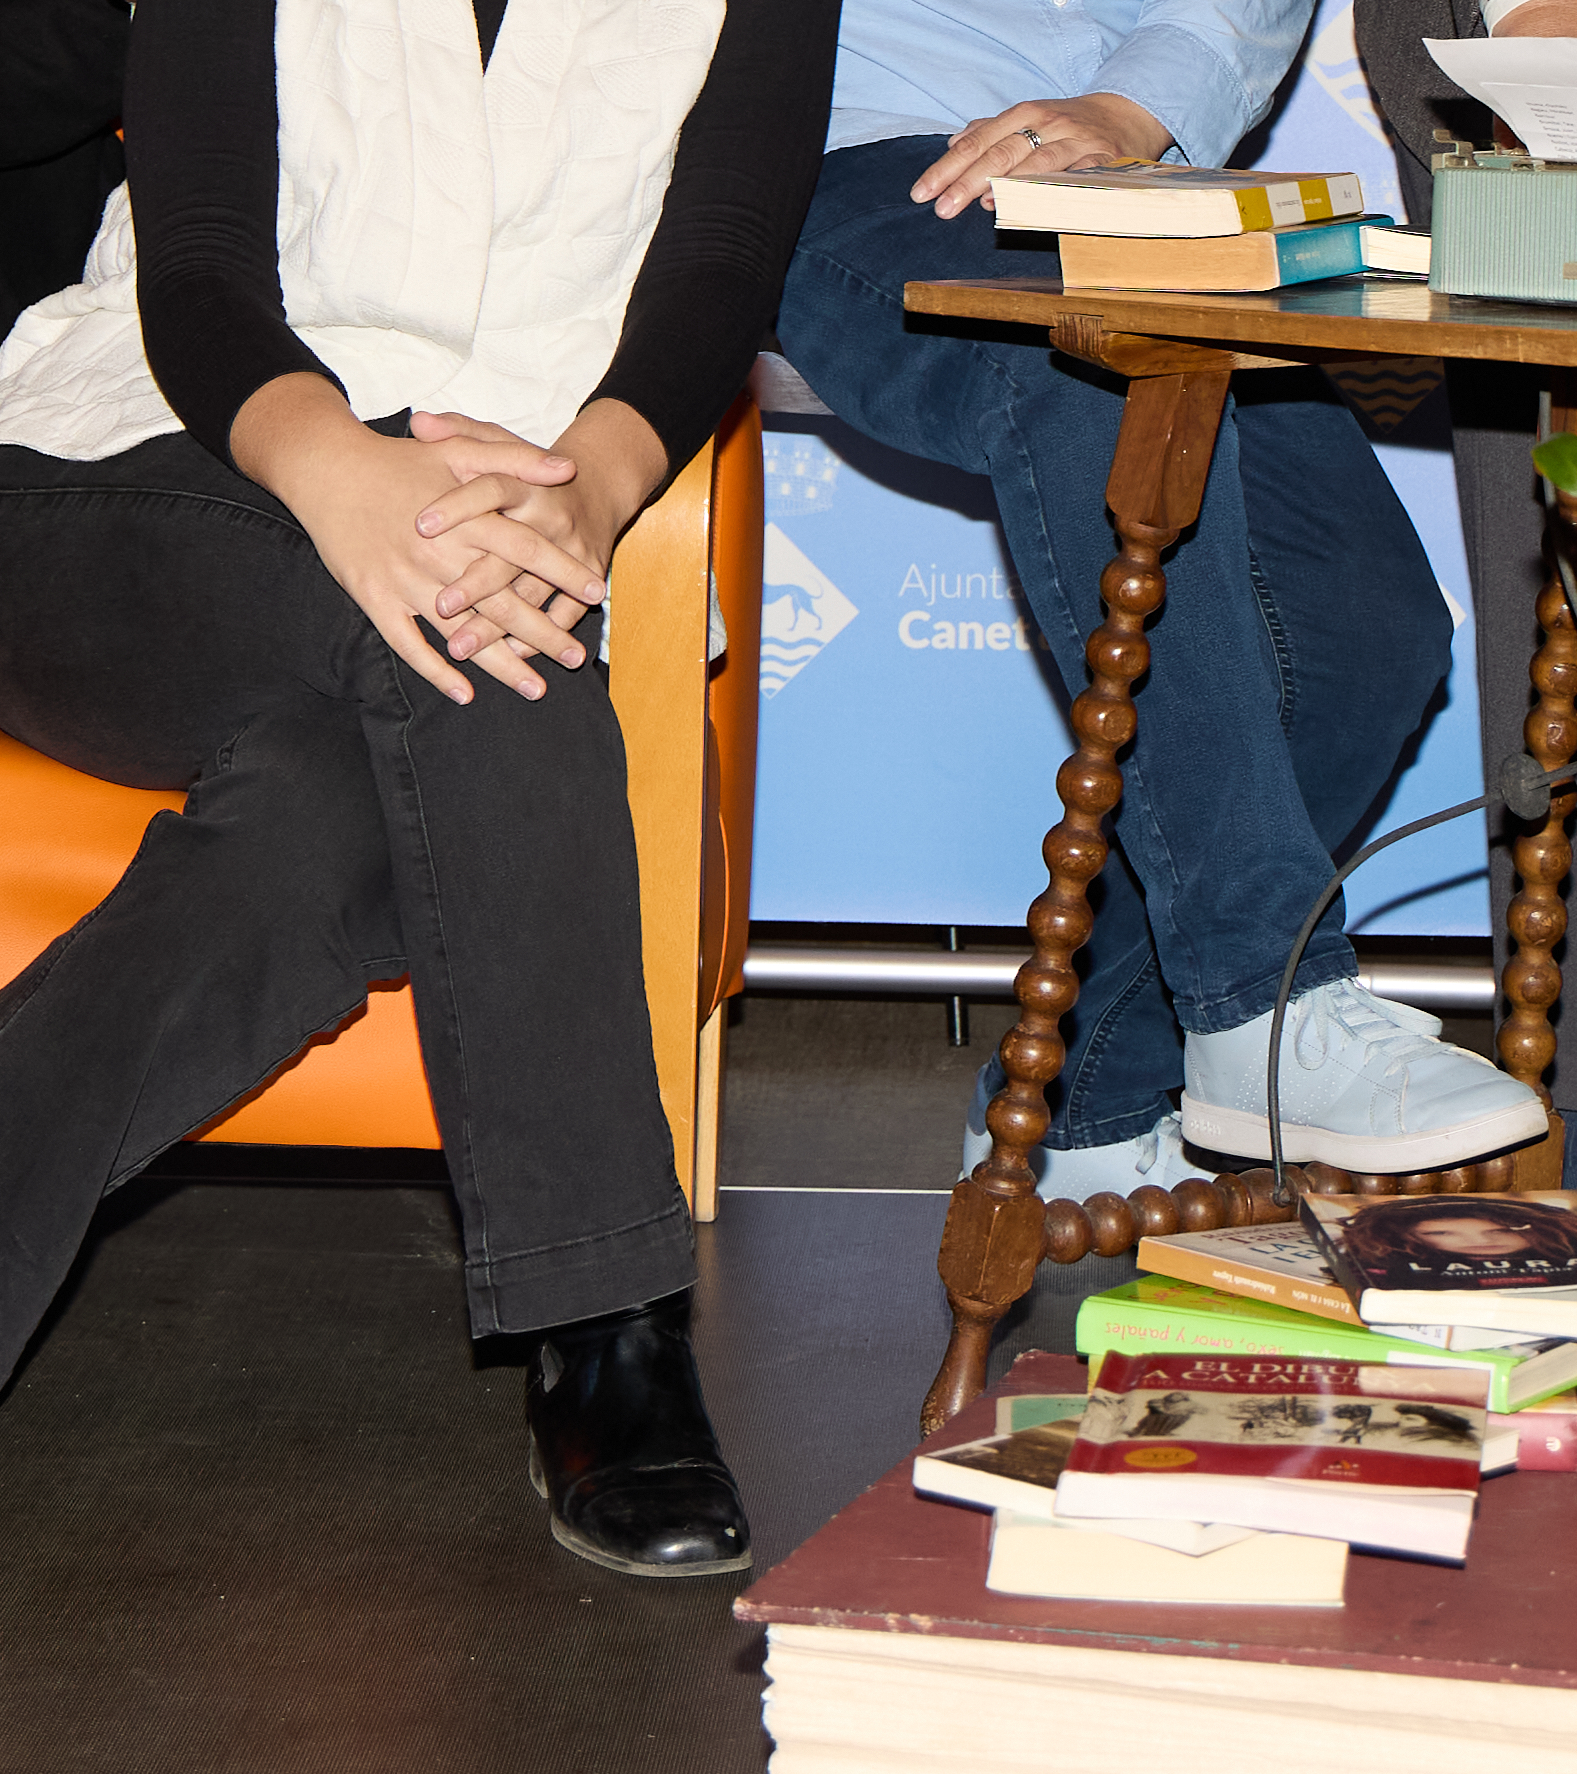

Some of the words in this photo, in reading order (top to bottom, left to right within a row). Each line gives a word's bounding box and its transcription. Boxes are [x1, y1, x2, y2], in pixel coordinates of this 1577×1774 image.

[898, 563, 1013, 607] Ajunt
[1104, 1321, 1170, 1344] pañales
[1176, 1326, 1186, 1343] y
[1192, 1332, 1234, 1349] amor
[1194, 1360, 1240, 1372] EL
